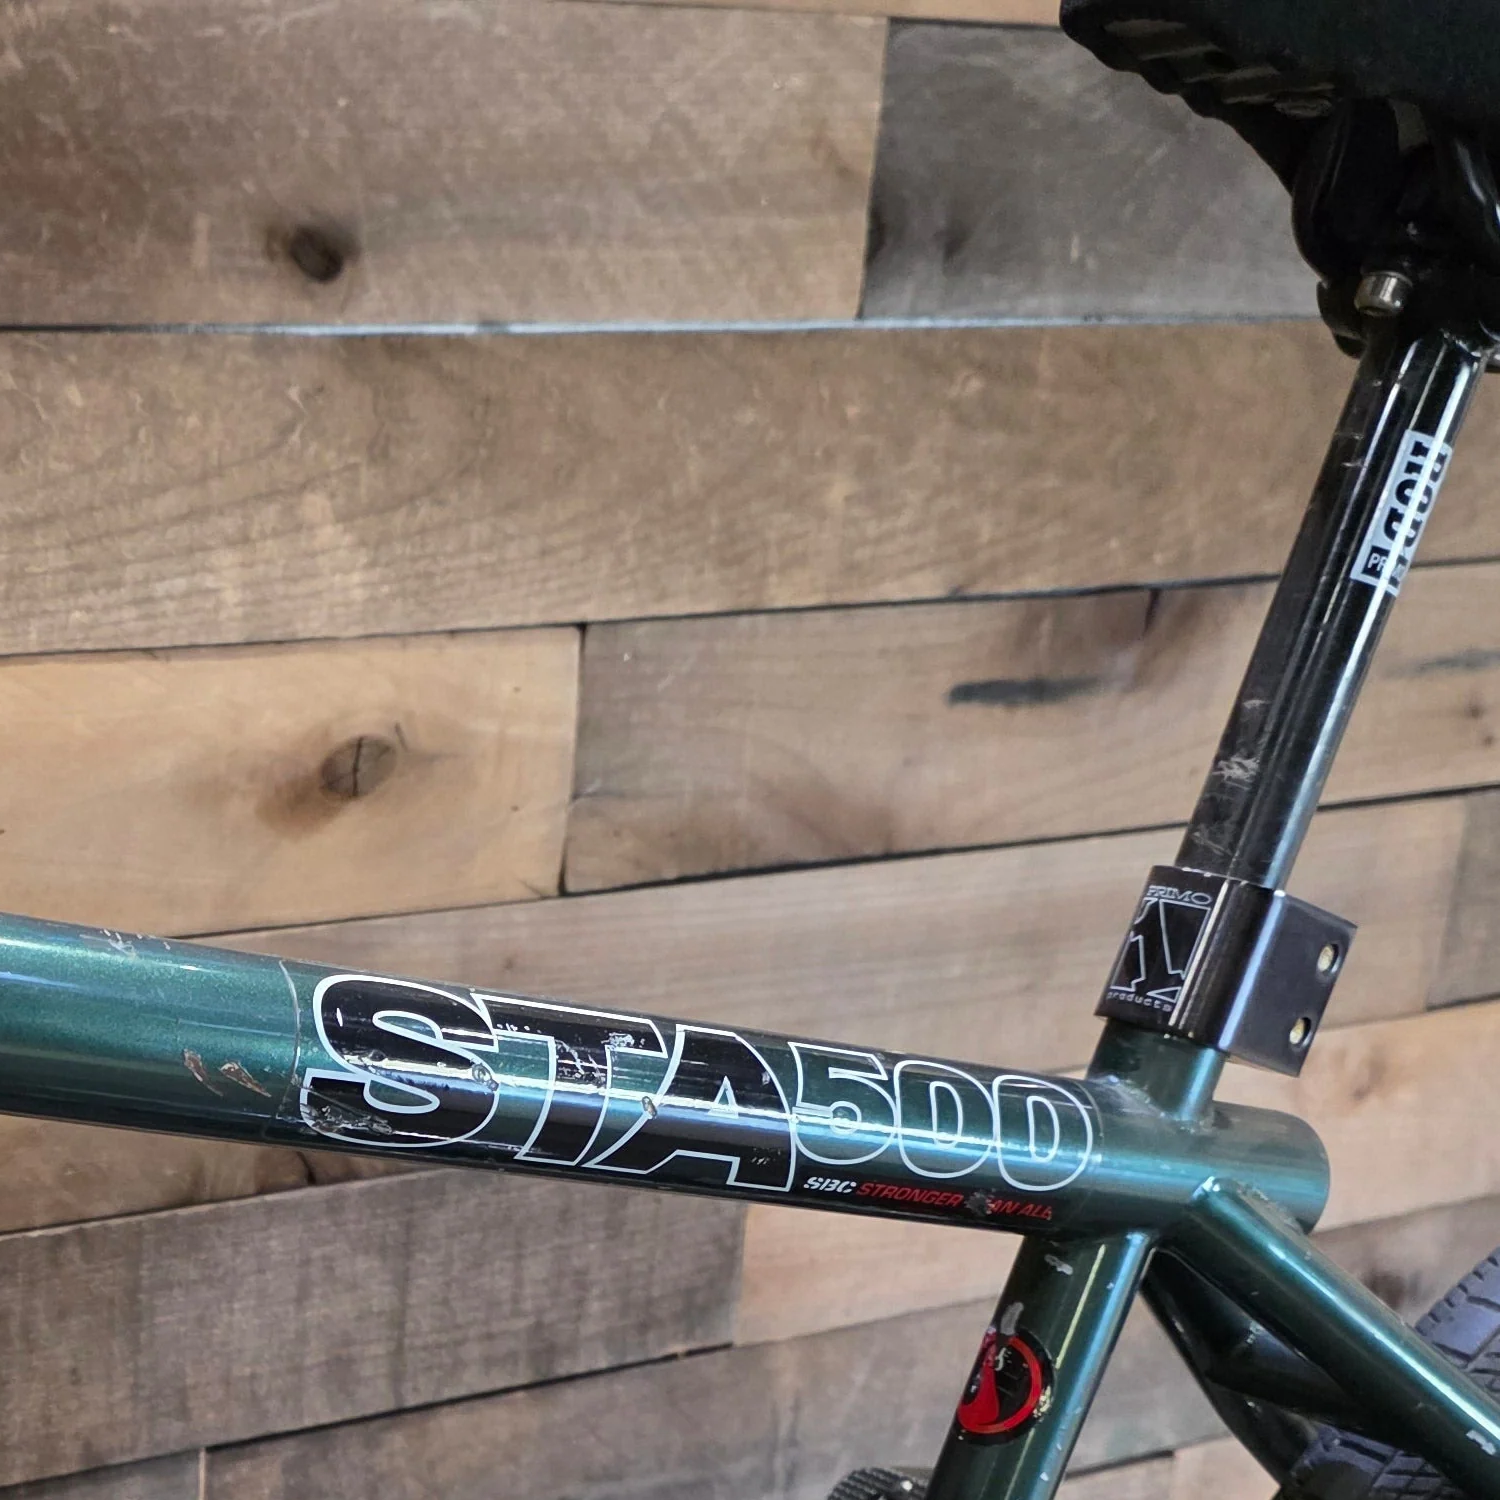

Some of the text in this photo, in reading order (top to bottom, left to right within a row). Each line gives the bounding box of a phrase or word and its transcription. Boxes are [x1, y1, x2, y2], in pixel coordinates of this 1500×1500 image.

[1147, 885, 1214, 905] PRIMO
[803, 1176, 857, 1194] SBC
[856, 1183, 964, 1207] STRONGER
